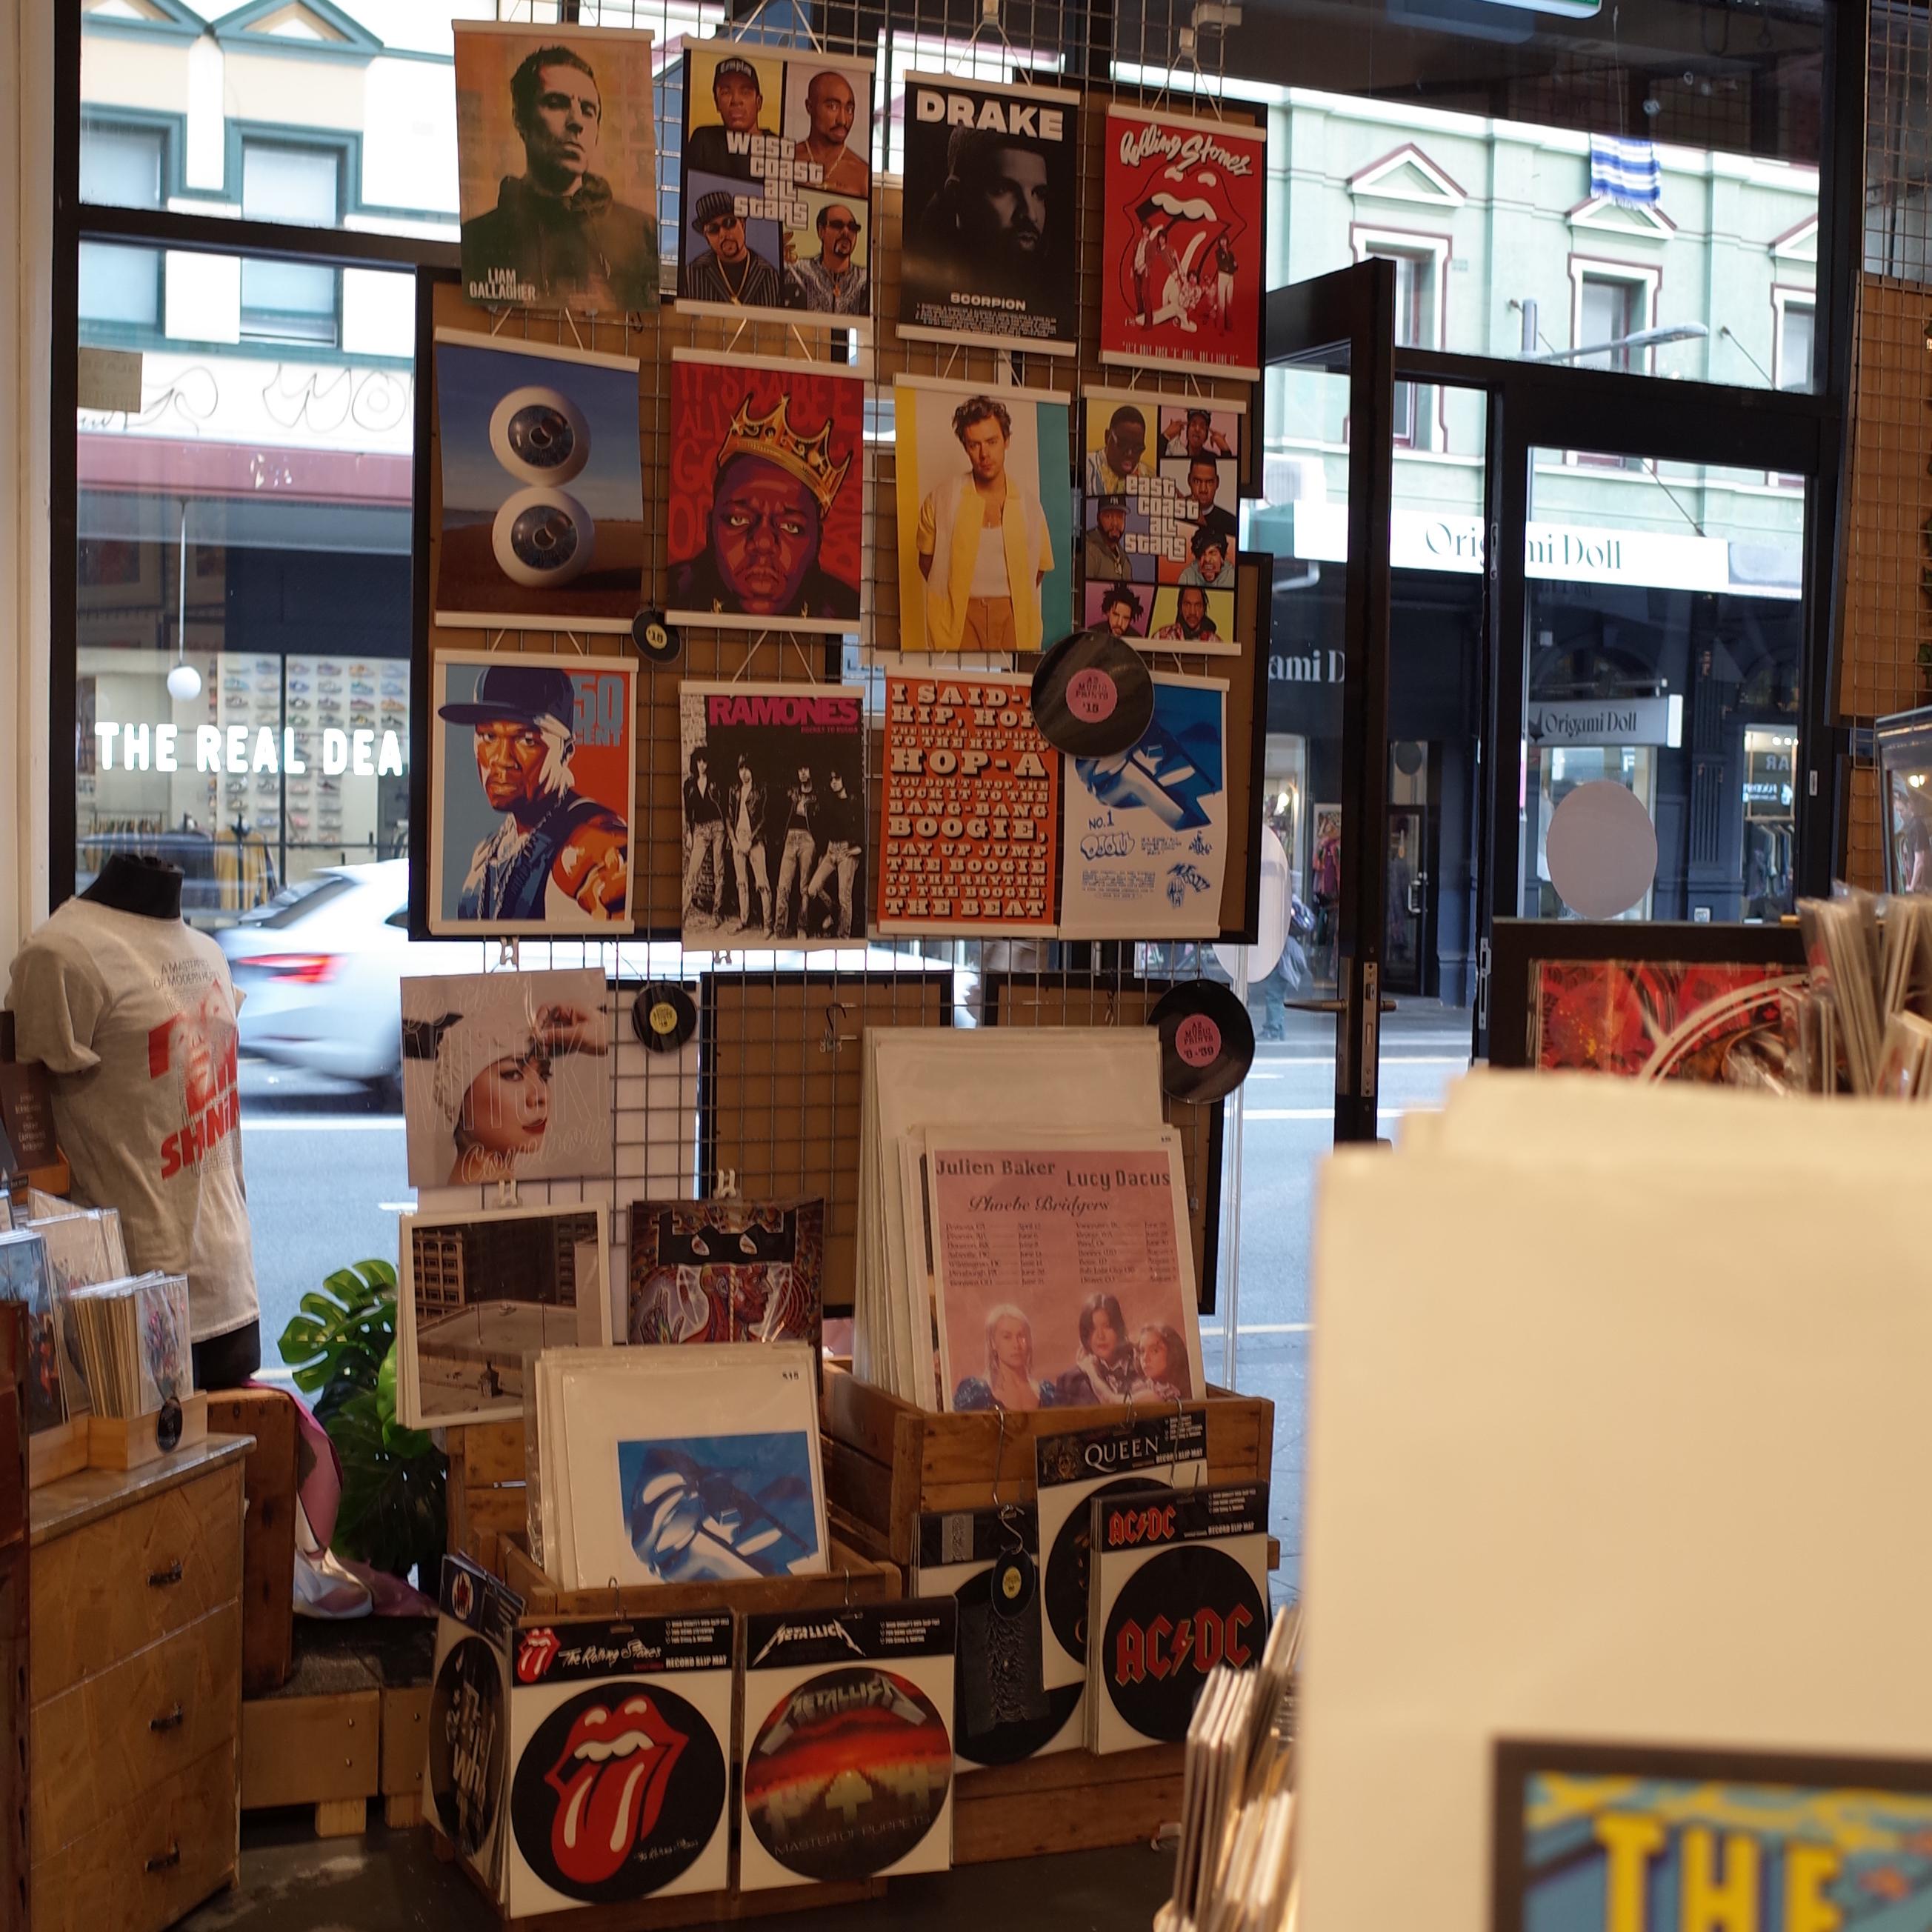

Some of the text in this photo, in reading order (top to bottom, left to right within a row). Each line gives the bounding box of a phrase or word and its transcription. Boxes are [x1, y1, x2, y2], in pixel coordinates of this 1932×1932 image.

[916, 89, 1063, 141] DRAKE
[1120, 124, 1253, 176] Rolling Stones
[750, 156, 823, 184] coast
[488, 267, 516, 284] LIAM
[470, 281, 535, 301] GALLAGHER
[950, 292, 1026, 312] SCORPION
[1138, 496, 1199, 520] coast
[1426, 522, 1621, 569] Orimi Doll
[1268, 650, 1321, 682] ami
[570, 675, 624, 726] 50
[892, 683, 1031, 707] I SAID-
[709, 696, 858, 726] RAMONES
[892, 705, 963, 727] HIP,
[574, 723, 623, 747] CENT
[1545, 712, 1637, 738] Origami Doll
[95, 722, 403, 776] THE REAL DEA
[891, 735, 1050, 752] TO THE HIP HIP
[890, 747, 1046, 777] HOP-A
[890, 777, 919, 787] YOU
[974, 779, 1013, 790] STOP
[1017, 780, 1049, 790] THE
[890, 787, 1048, 802] ROCK IT TO THE
[888, 817, 1046, 843] BOOGIE,
[887, 842, 1046, 859] SAY UP JUMP
[887, 857, 1045, 874] THE BOOGIE
[885, 885, 910, 897] OF
[917, 886, 959, 898] THE
[886, 873, 1046, 887] TO THE RHYTHM
[885, 899, 1045, 917] THE BEAT
[403, 1022, 606, 1132] MITSKI
[936, 1159, 1056, 1176] Julien Baker
[1066, 1170, 1170, 1190] Lucy Dacus
[968, 1196, 1110, 1216] Phoebe Bridgers
[1085, 1435, 1159, 1473] QUEEN
[559, 1639, 662, 1670] The Rolling Stones
[753, 1618, 866, 1667] METALLICA
[666, 1656, 695, 1668] RECORD
[696, 1655, 711, 1666] SLIP
[712, 1654, 727, 1665] MAT
[759, 1672, 927, 1755] METALLICA
[1592, 1811, 1843, 1932] THE
